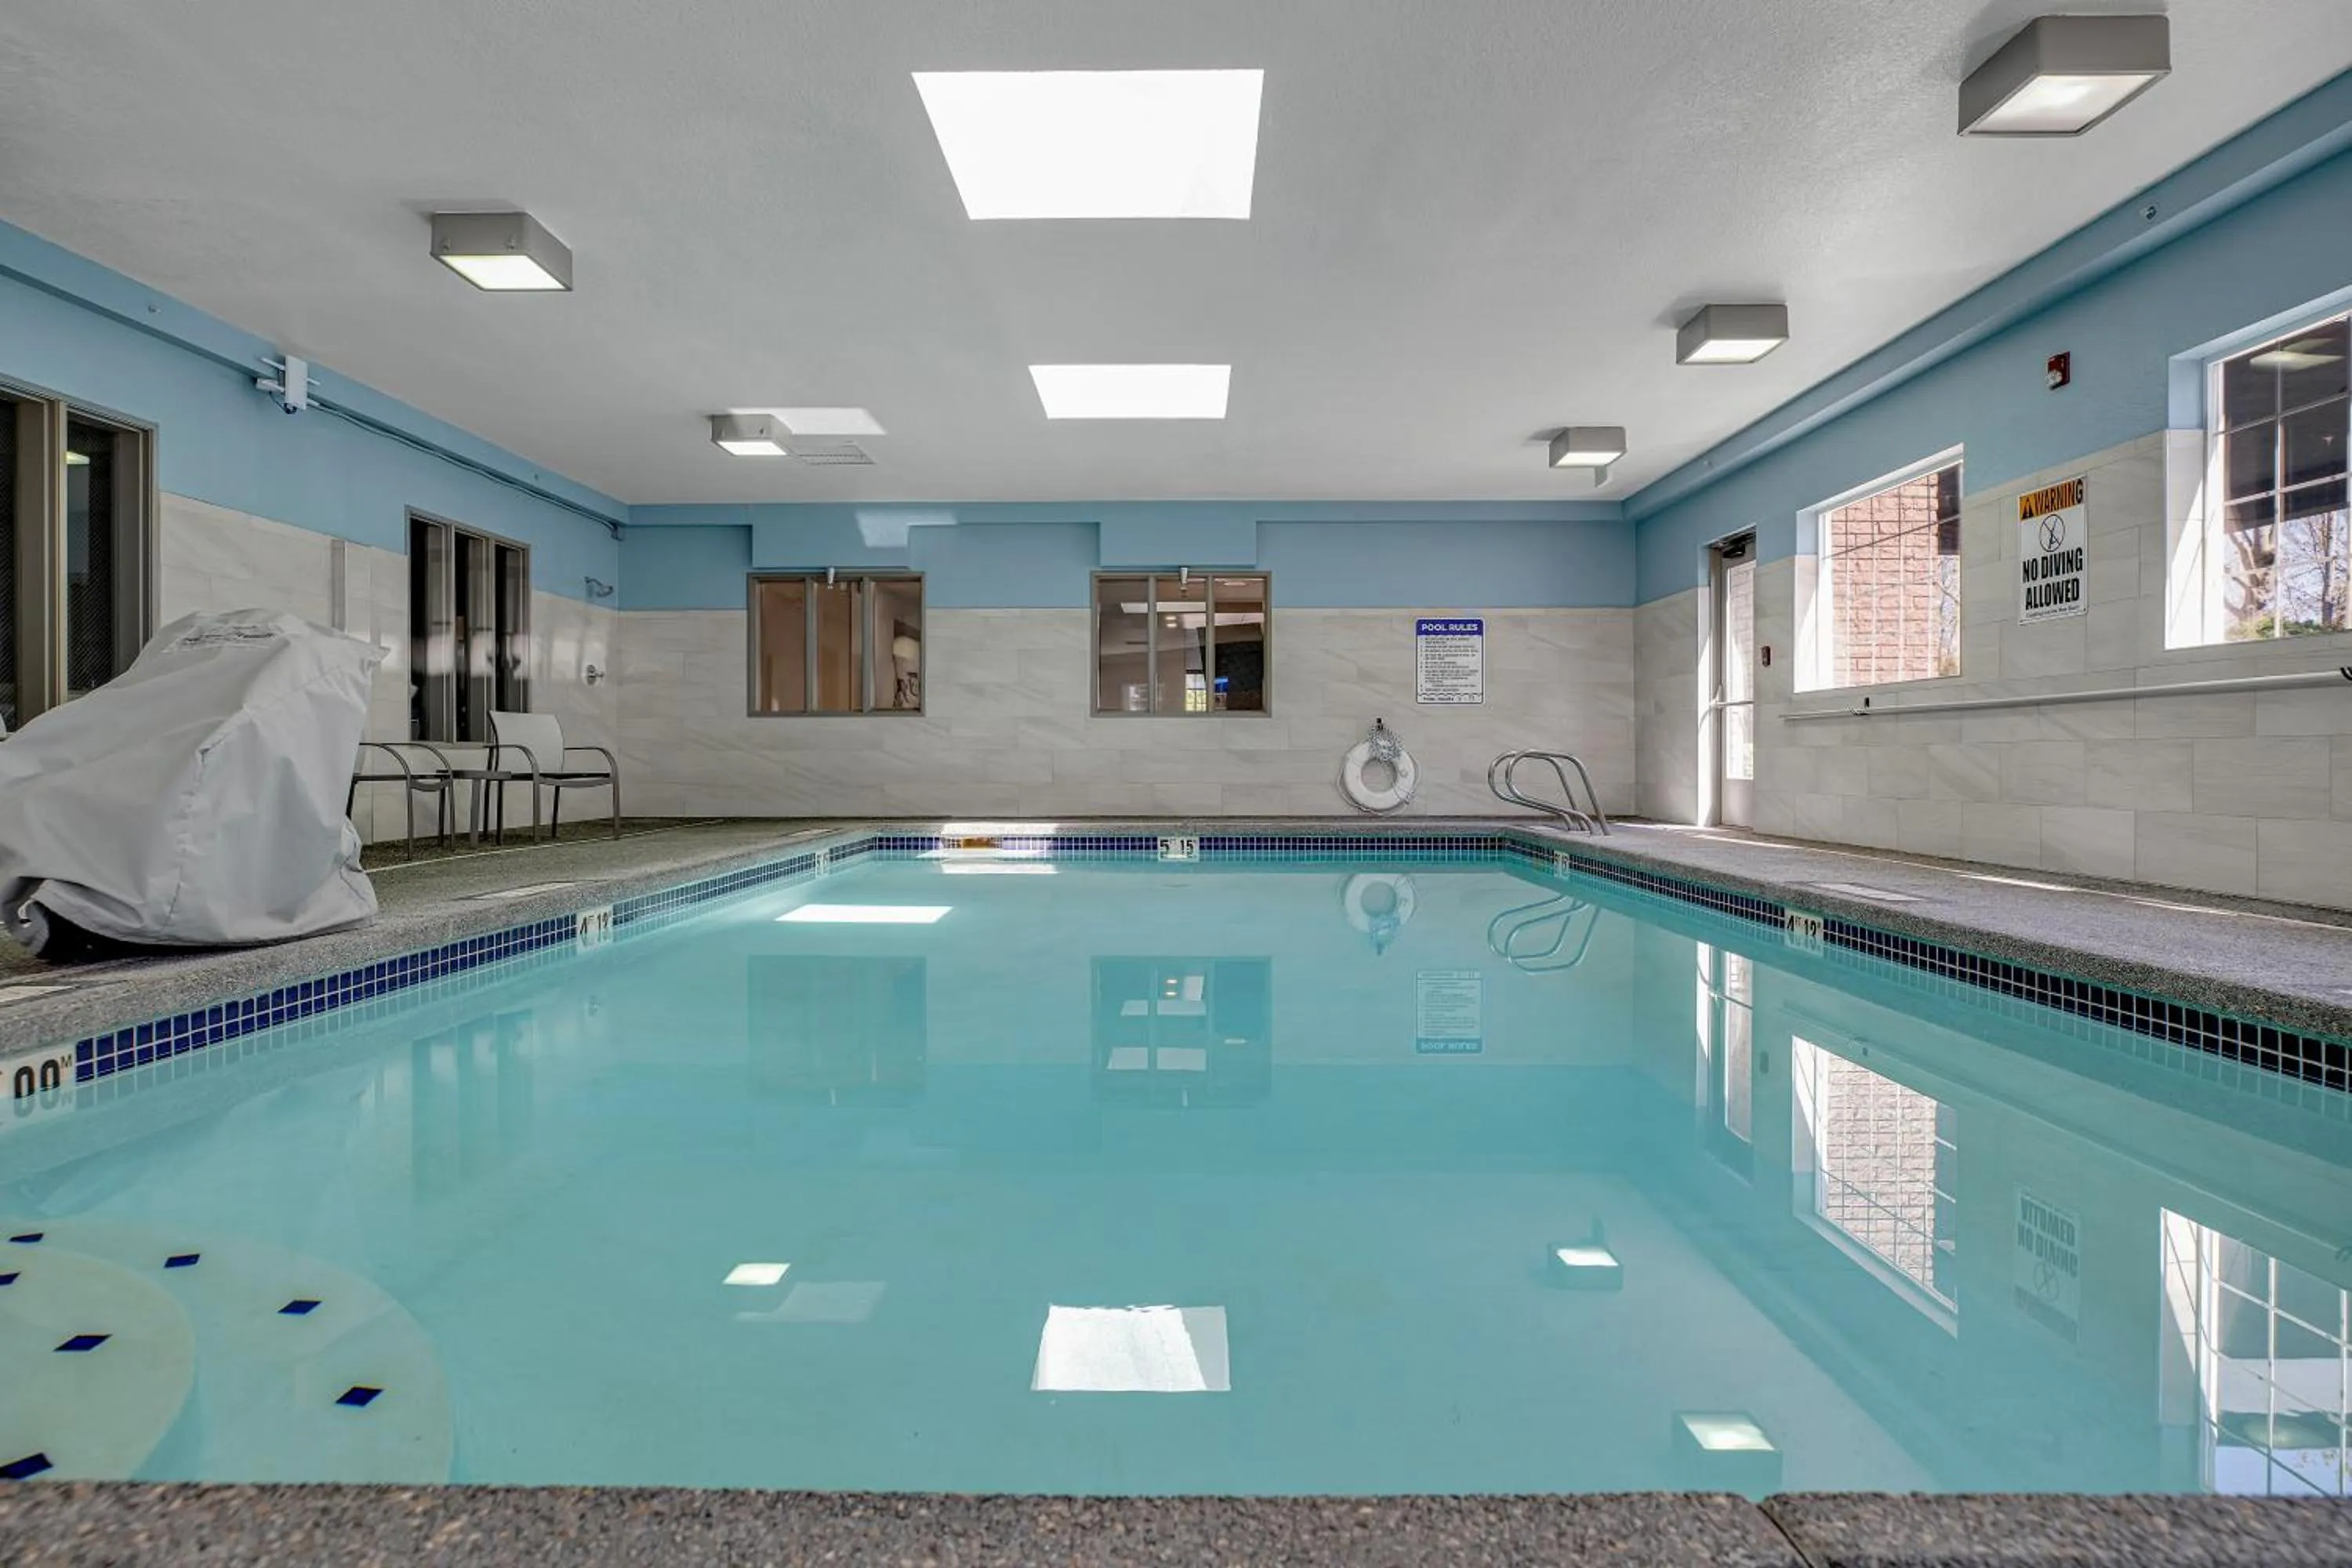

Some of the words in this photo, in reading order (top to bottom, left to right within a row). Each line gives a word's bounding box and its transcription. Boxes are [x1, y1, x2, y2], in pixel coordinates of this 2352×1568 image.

[2034, 478, 2084, 515] WARNING
[2022, 558, 2038, 583] NO
[2041, 547, 2083, 579] DIVING
[2025, 578, 2080, 610] ALLOWED
